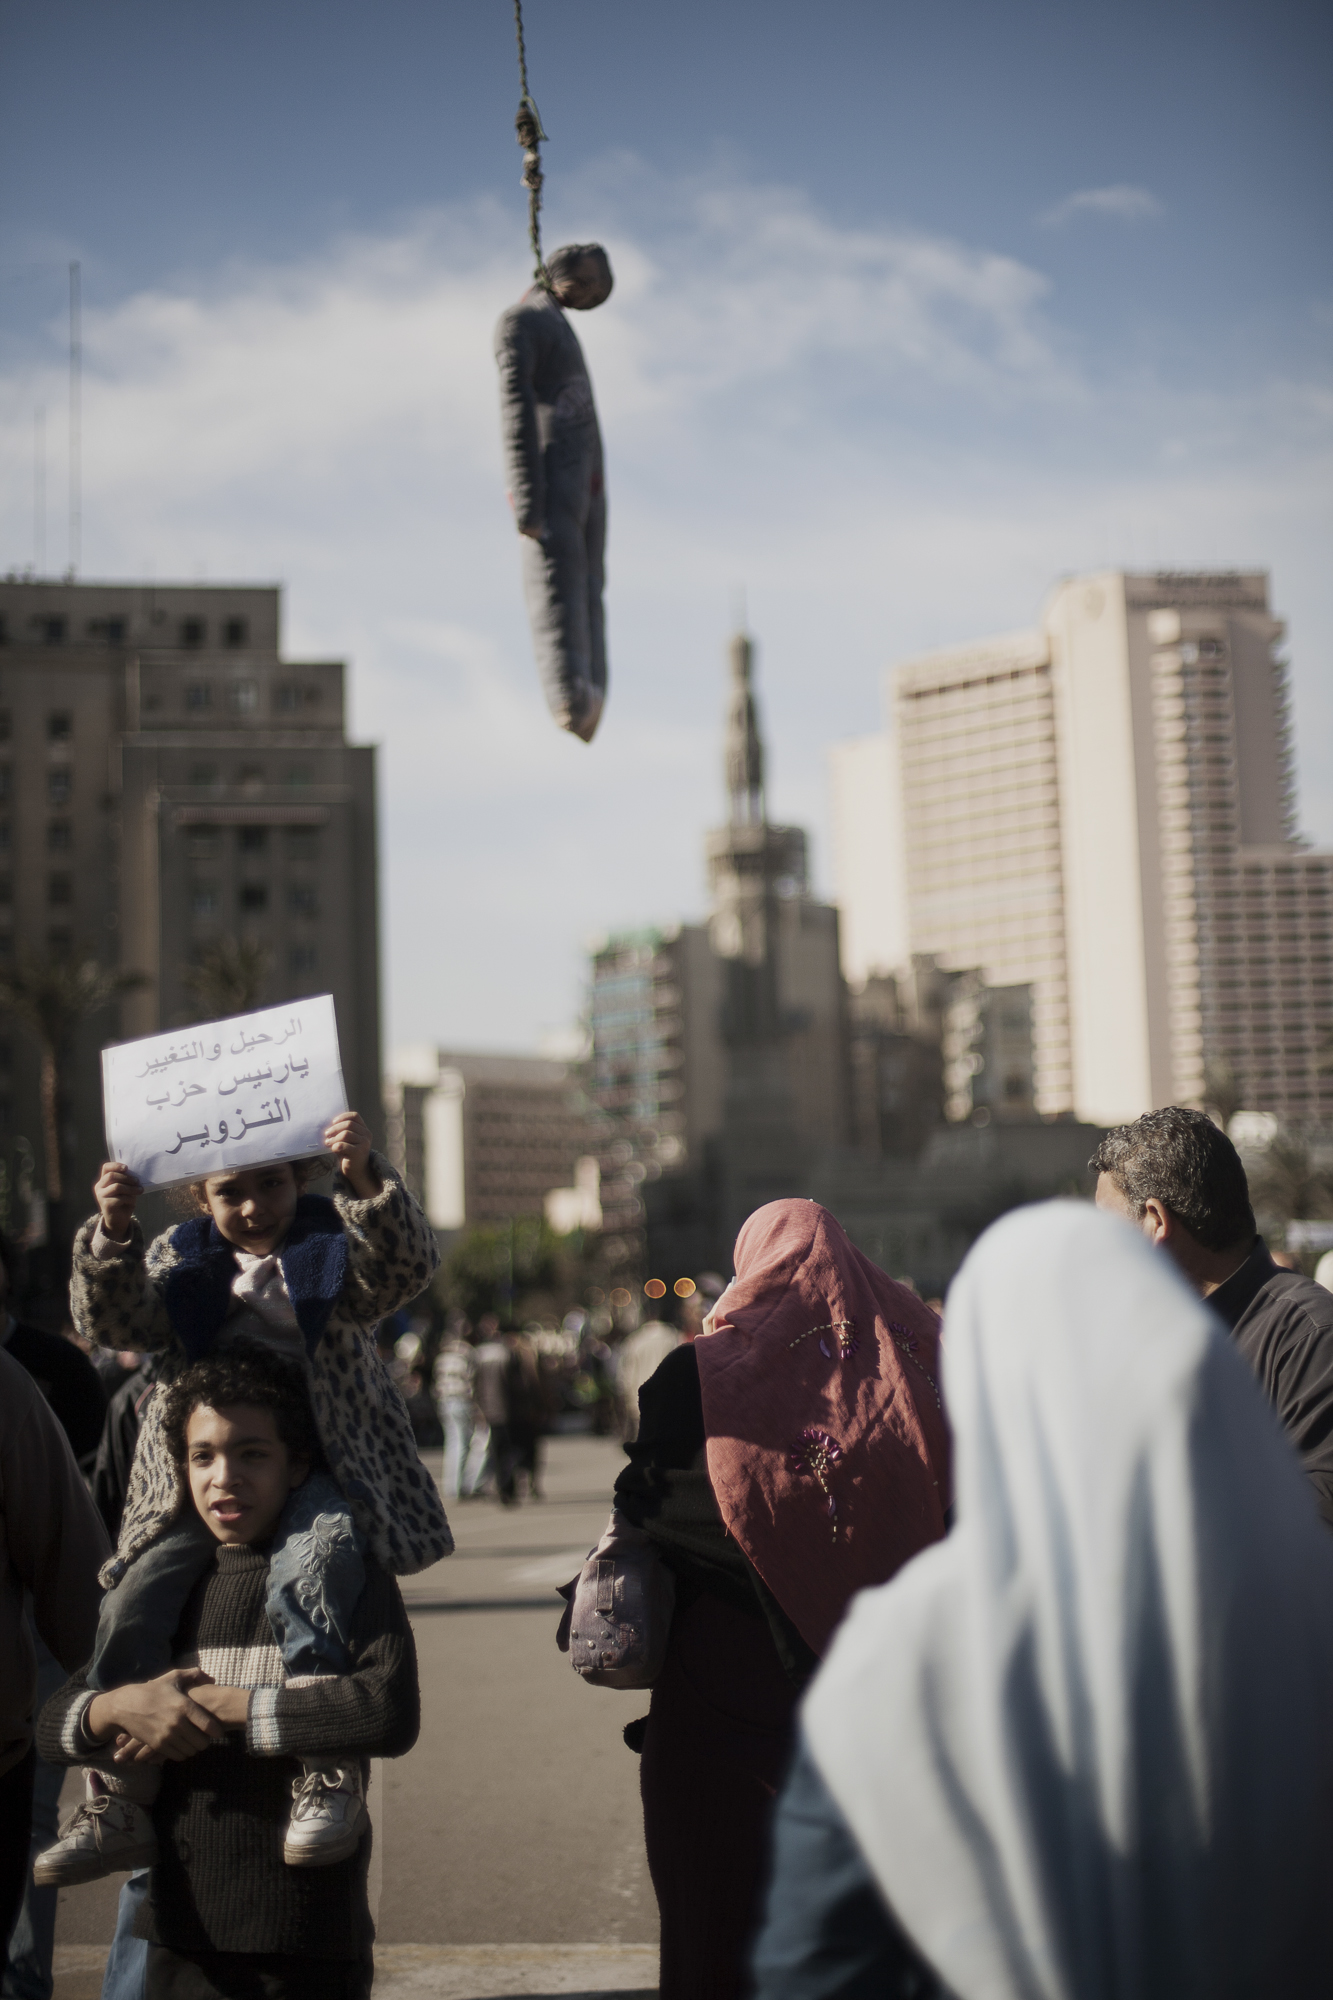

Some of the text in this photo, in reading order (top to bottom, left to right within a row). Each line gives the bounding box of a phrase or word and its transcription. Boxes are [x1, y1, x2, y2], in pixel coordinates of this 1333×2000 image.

[135, 1017, 303, 1078] الرحيل والتغيير
[145, 1080, 208, 1111] حزب
